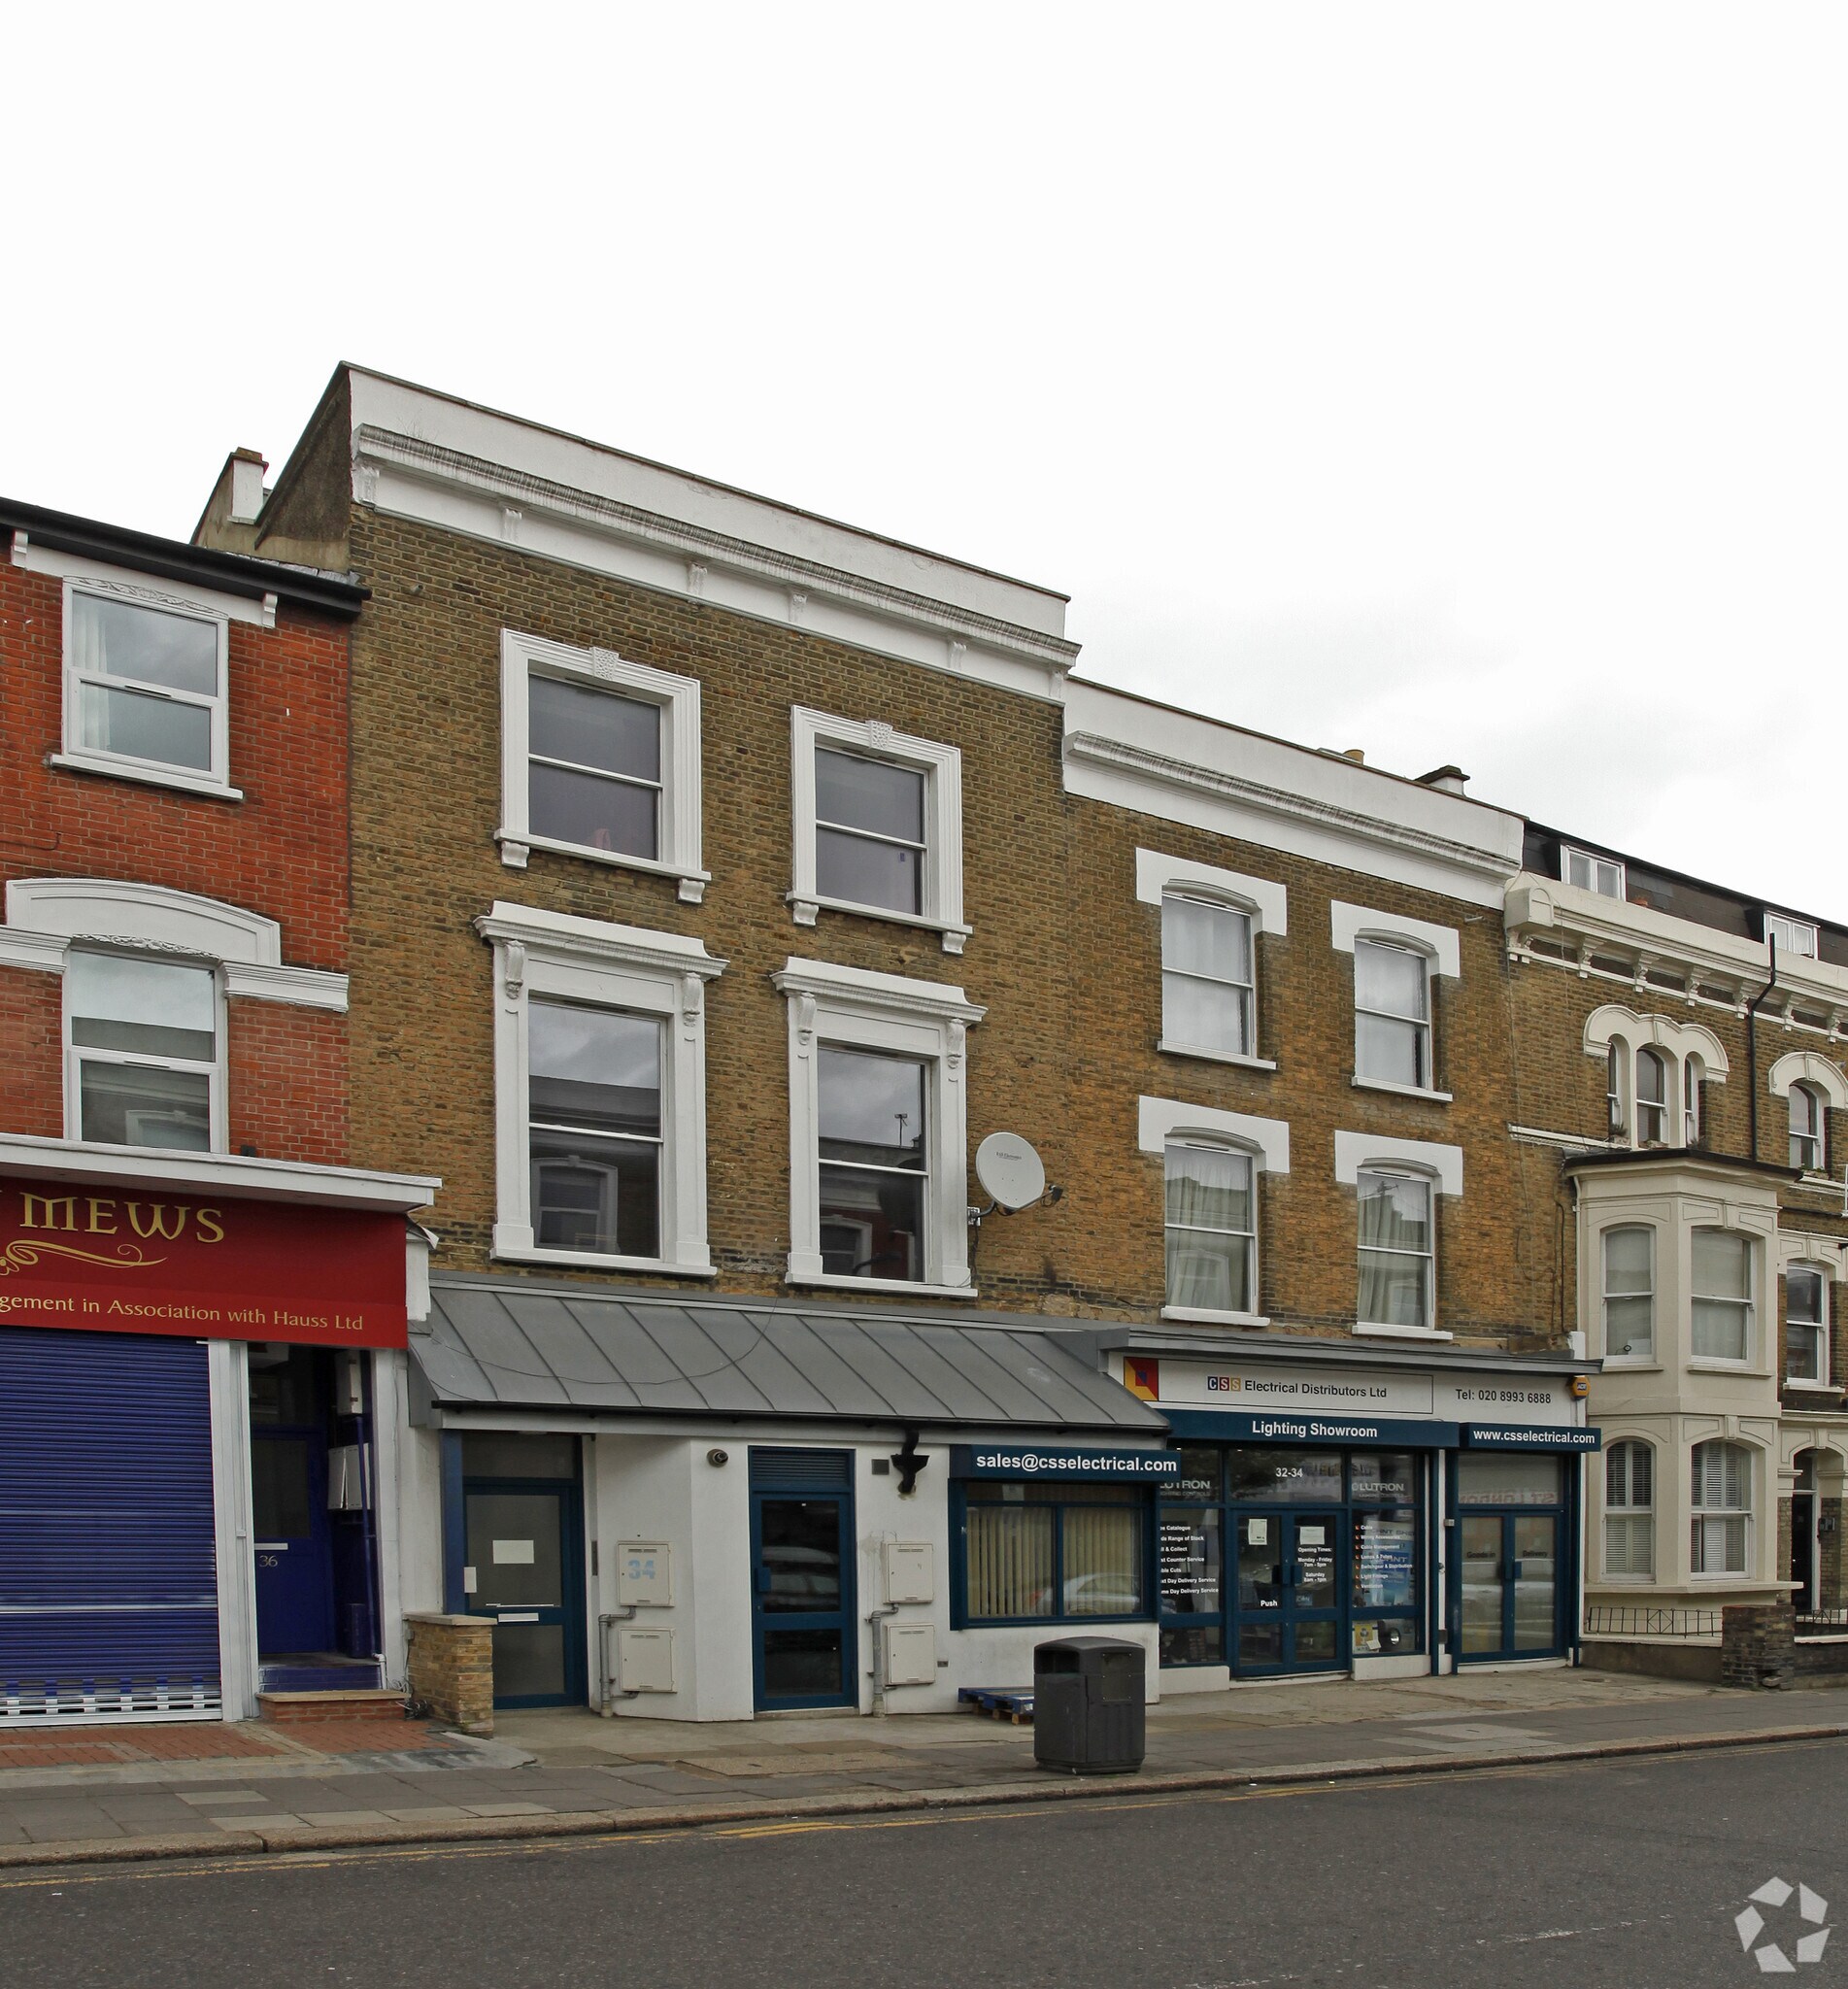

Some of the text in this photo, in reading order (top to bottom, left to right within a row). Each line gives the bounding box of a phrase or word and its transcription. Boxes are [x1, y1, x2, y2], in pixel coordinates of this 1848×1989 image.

[19, 1192, 224, 1243] MEWS
[0, 1296, 363, 1331] gement in Association with Hauss Ltd
[1208, 1376, 1387, 1398] CSS Electrical Distributors Ltd
[1456, 1389, 1551, 1404] Tel: 020 8993 6888
[1252, 1421, 1378, 1437] Lighting Showroom
[1473, 1430, 1596, 1444] www.csselectrical.com
[976, 1453, 1177, 1472] sales@csselectrical.com
[1275, 1467, 1303, 1477] 32-34
[258, 1556, 278, 1568] 36
[628, 1560, 655, 1580] 34
